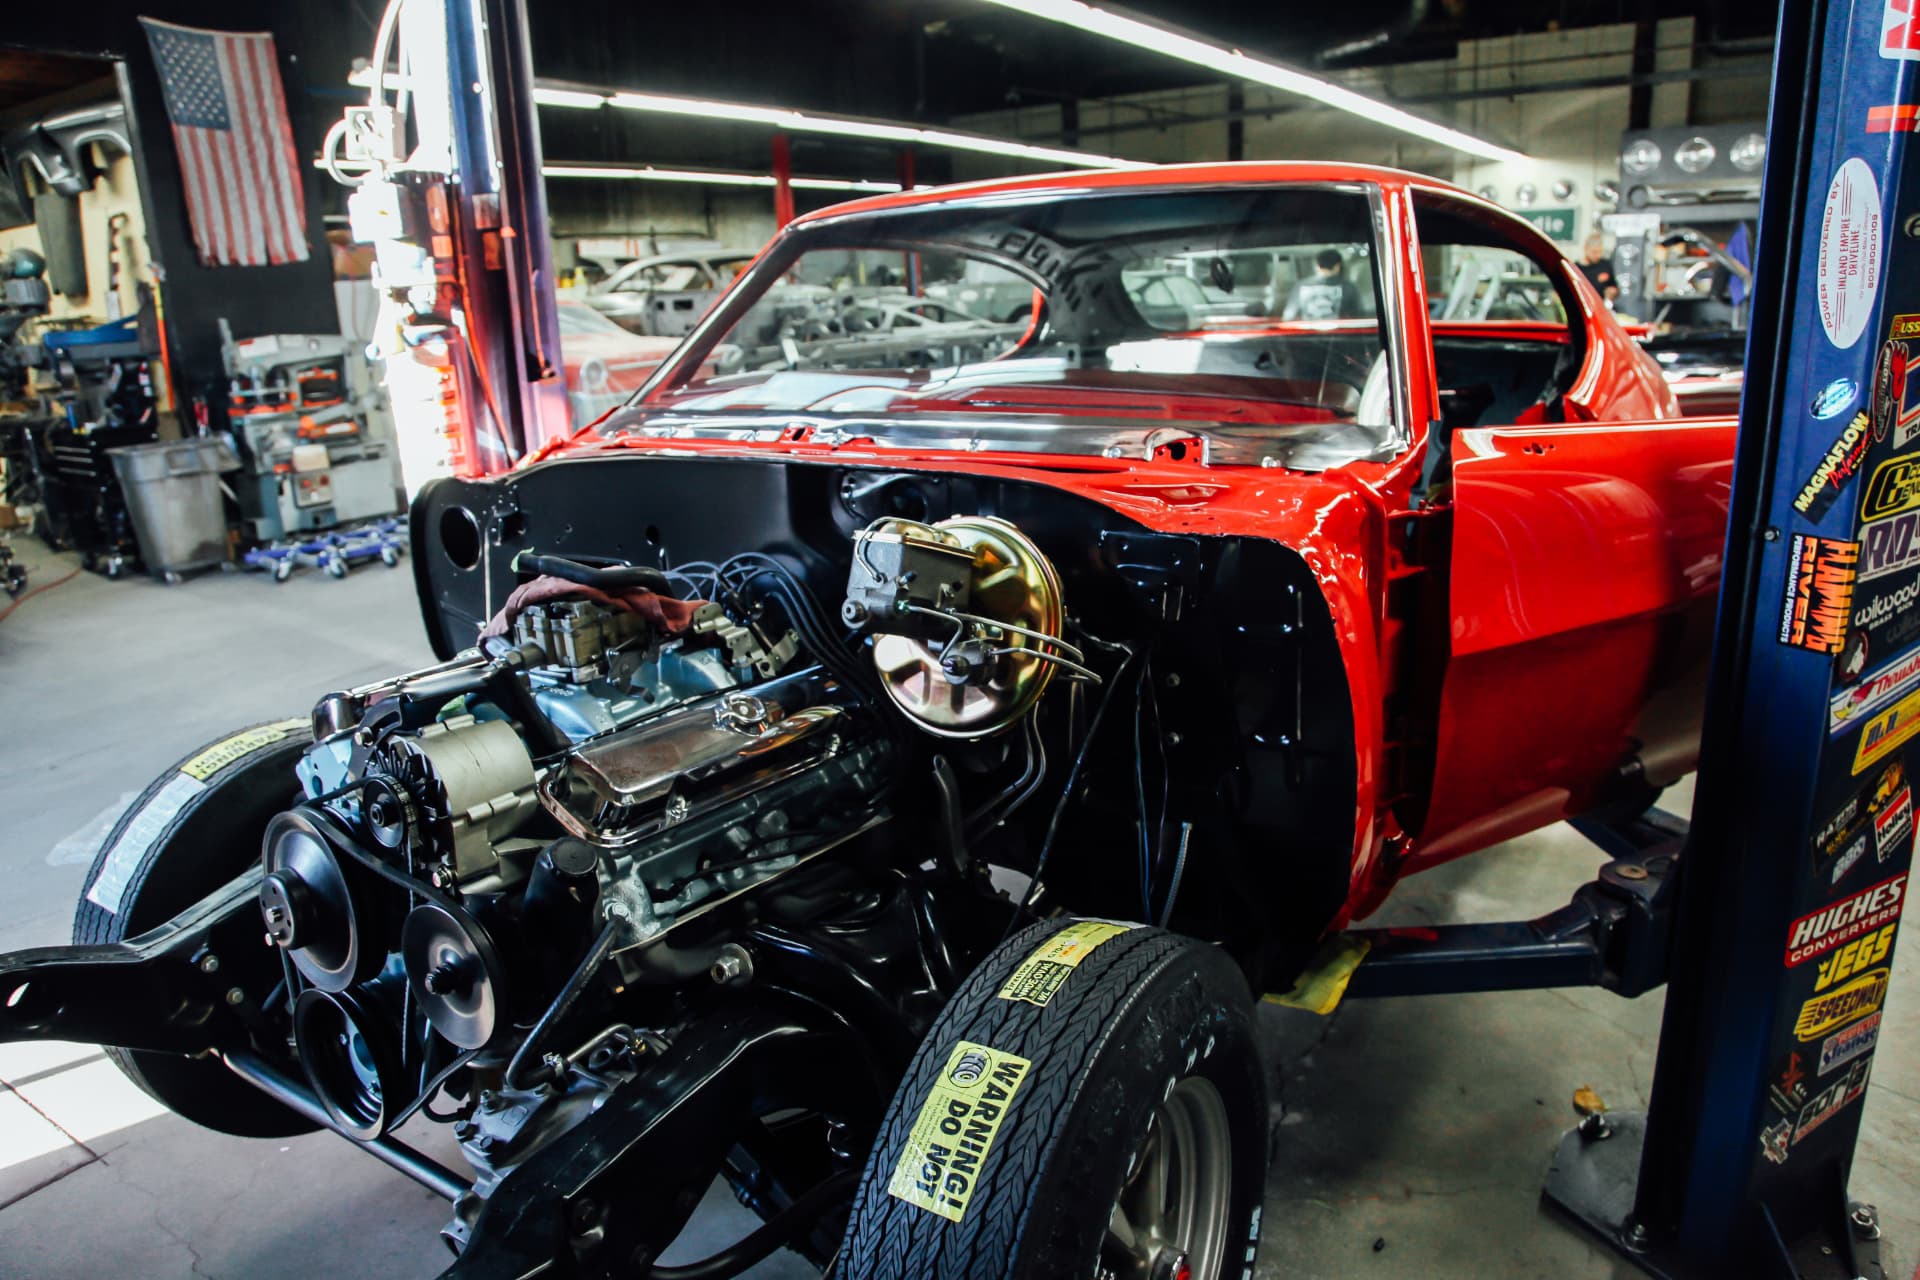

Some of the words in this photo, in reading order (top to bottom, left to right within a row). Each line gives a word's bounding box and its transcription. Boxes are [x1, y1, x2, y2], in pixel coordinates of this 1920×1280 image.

[1830, 181, 1841, 200] BY
[1820, 206, 1834, 277] DELIVERED
[1840, 218, 1851, 248] EMPIRE
[1848, 230, 1861, 276] DRIVELINE
[1838, 250, 1848, 290] INLAND
[1820, 283, 1833, 329] POWER
[1793, 412, 1870, 513] MAGNAFLOW
[1786, 535, 1804, 597] PERFORMANCE
[1791, 537, 1818, 645] RIVER
[1779, 597, 1795, 643] PRODUCTS
[1805, 539, 1861, 654] FLAMING
[1878, 803, 1911, 844] Holley
[1789, 876, 1906, 949] HUGHES
[1791, 904, 1899, 962] CONVERTERS
[1018, 978, 1038, 998] WIDE
[1033, 961, 1055, 982] OVAL
[1814, 922, 1896, 992] JEGS
[940, 1098, 972, 1136] DO
[943, 1061, 1024, 1210] WARNING!
[916, 1142, 952, 1199] NOT
